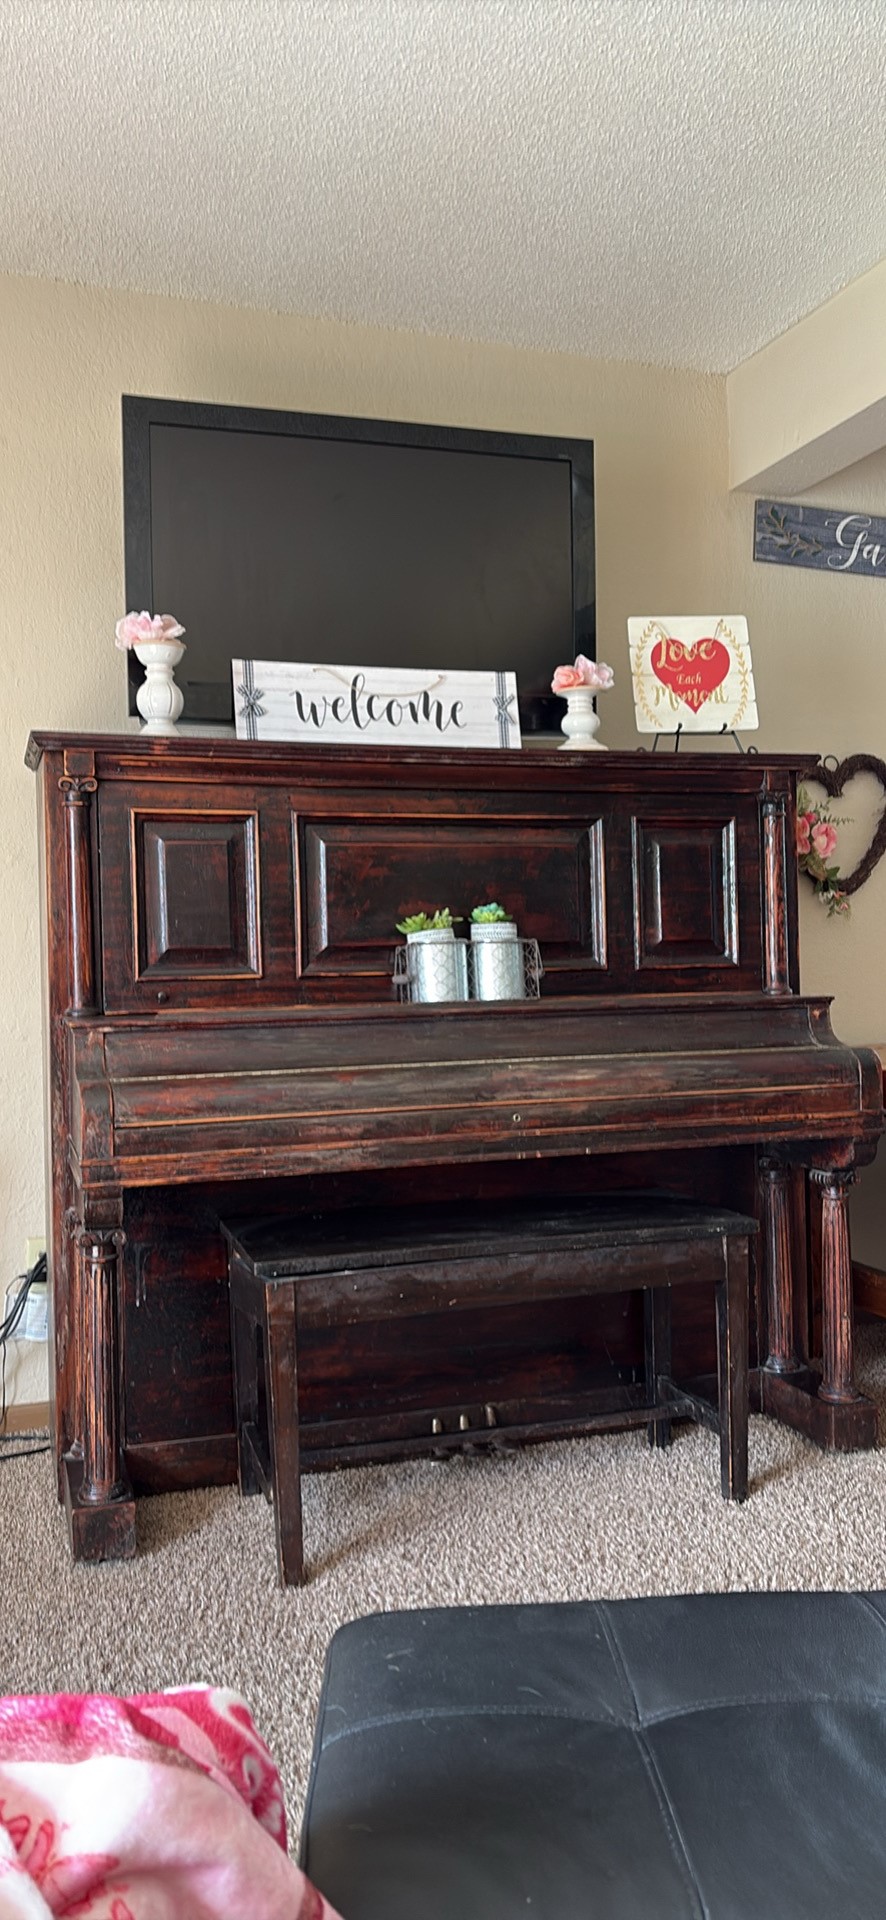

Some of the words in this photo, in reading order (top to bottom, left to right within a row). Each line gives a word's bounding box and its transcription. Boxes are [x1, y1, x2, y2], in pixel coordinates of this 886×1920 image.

[655, 632, 717, 672] Love
[676, 672, 702, 685] Each
[289, 672, 467, 732] welcome
[651, 682, 729, 711] Moment
